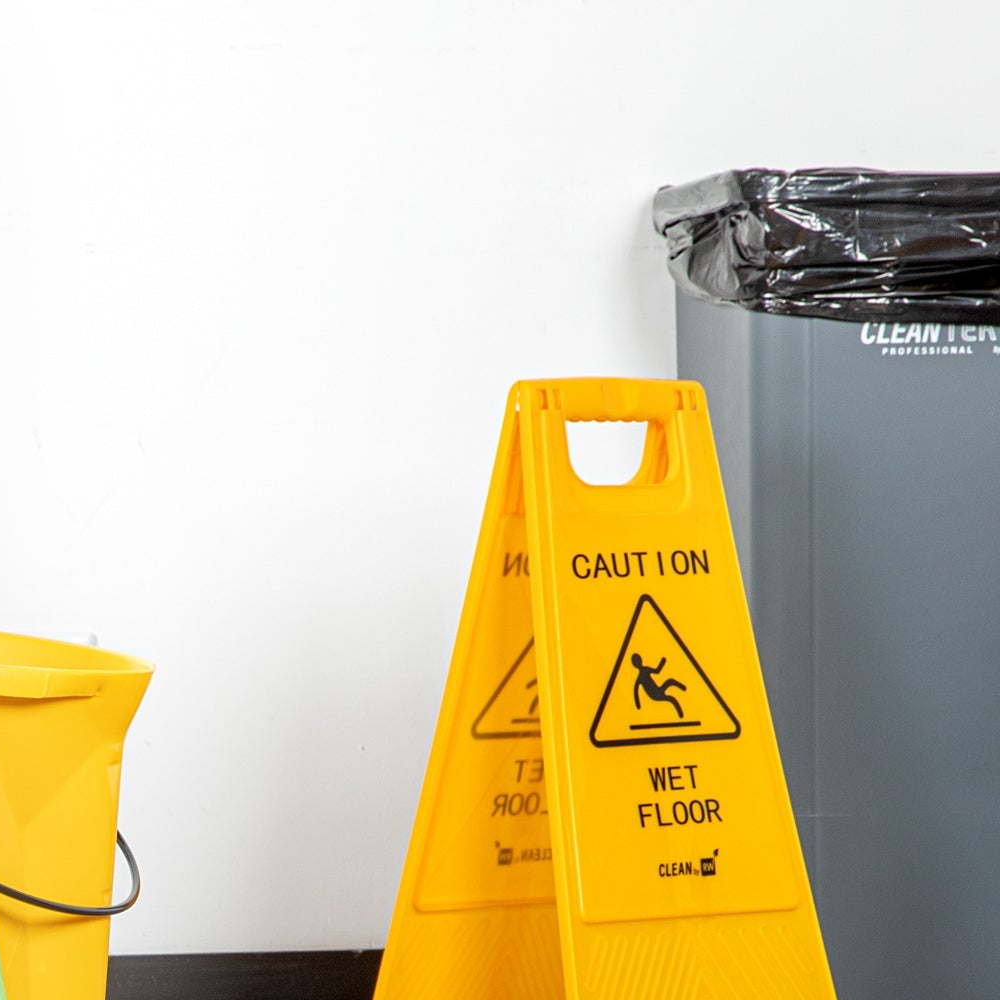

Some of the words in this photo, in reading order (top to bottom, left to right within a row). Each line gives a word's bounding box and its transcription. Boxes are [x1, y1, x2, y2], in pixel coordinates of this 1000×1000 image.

[881, 345, 973, 355] PROFESSIONAL
[571, 549, 710, 579] CAUTION
[648, 764, 699, 792] WET
[637, 798, 723, 828] FLOOR
[658, 862, 693, 877] CLEAN
